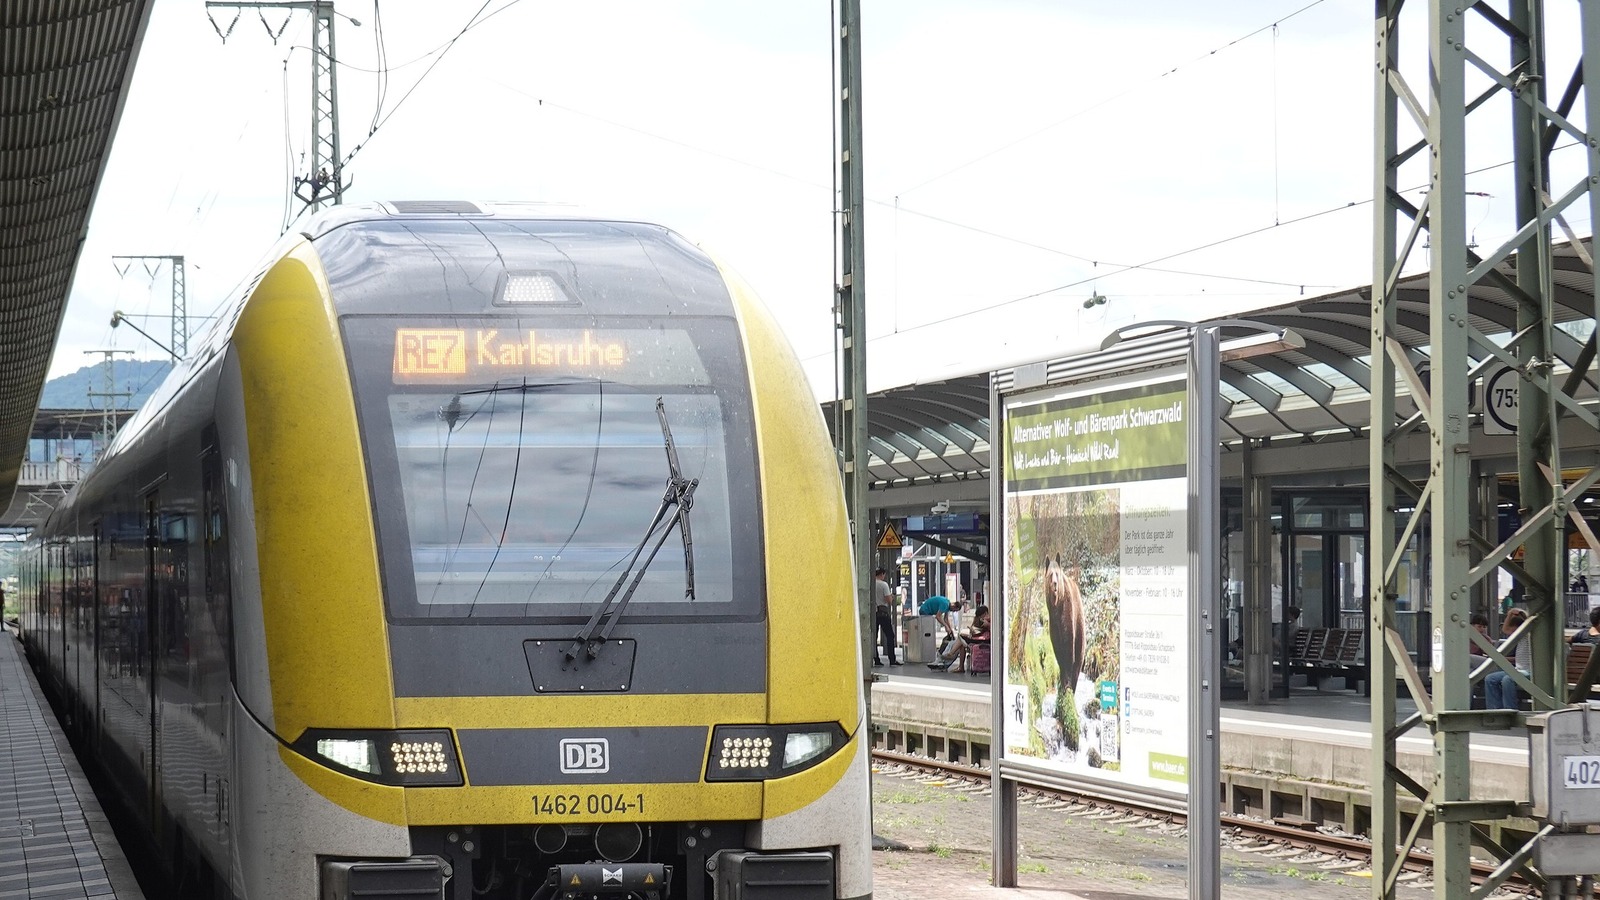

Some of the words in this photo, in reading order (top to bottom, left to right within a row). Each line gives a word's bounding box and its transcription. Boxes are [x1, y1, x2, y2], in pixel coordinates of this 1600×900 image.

[477, 329, 625, 366] Karlsruhe
[1013, 422, 1052, 443] Alternativer
[1054, 418, 1073, 437] Wolf-
[1074, 415, 1088, 436] und
[1090, 412, 1128, 435] Bärenpark
[1129, 401, 1182, 427] Schwarzwald
[565, 743, 604, 769] DB
[1568, 760, 1600, 785] 402
[531, 795, 581, 815] 1462
[587, 793, 644, 814] 004-1
